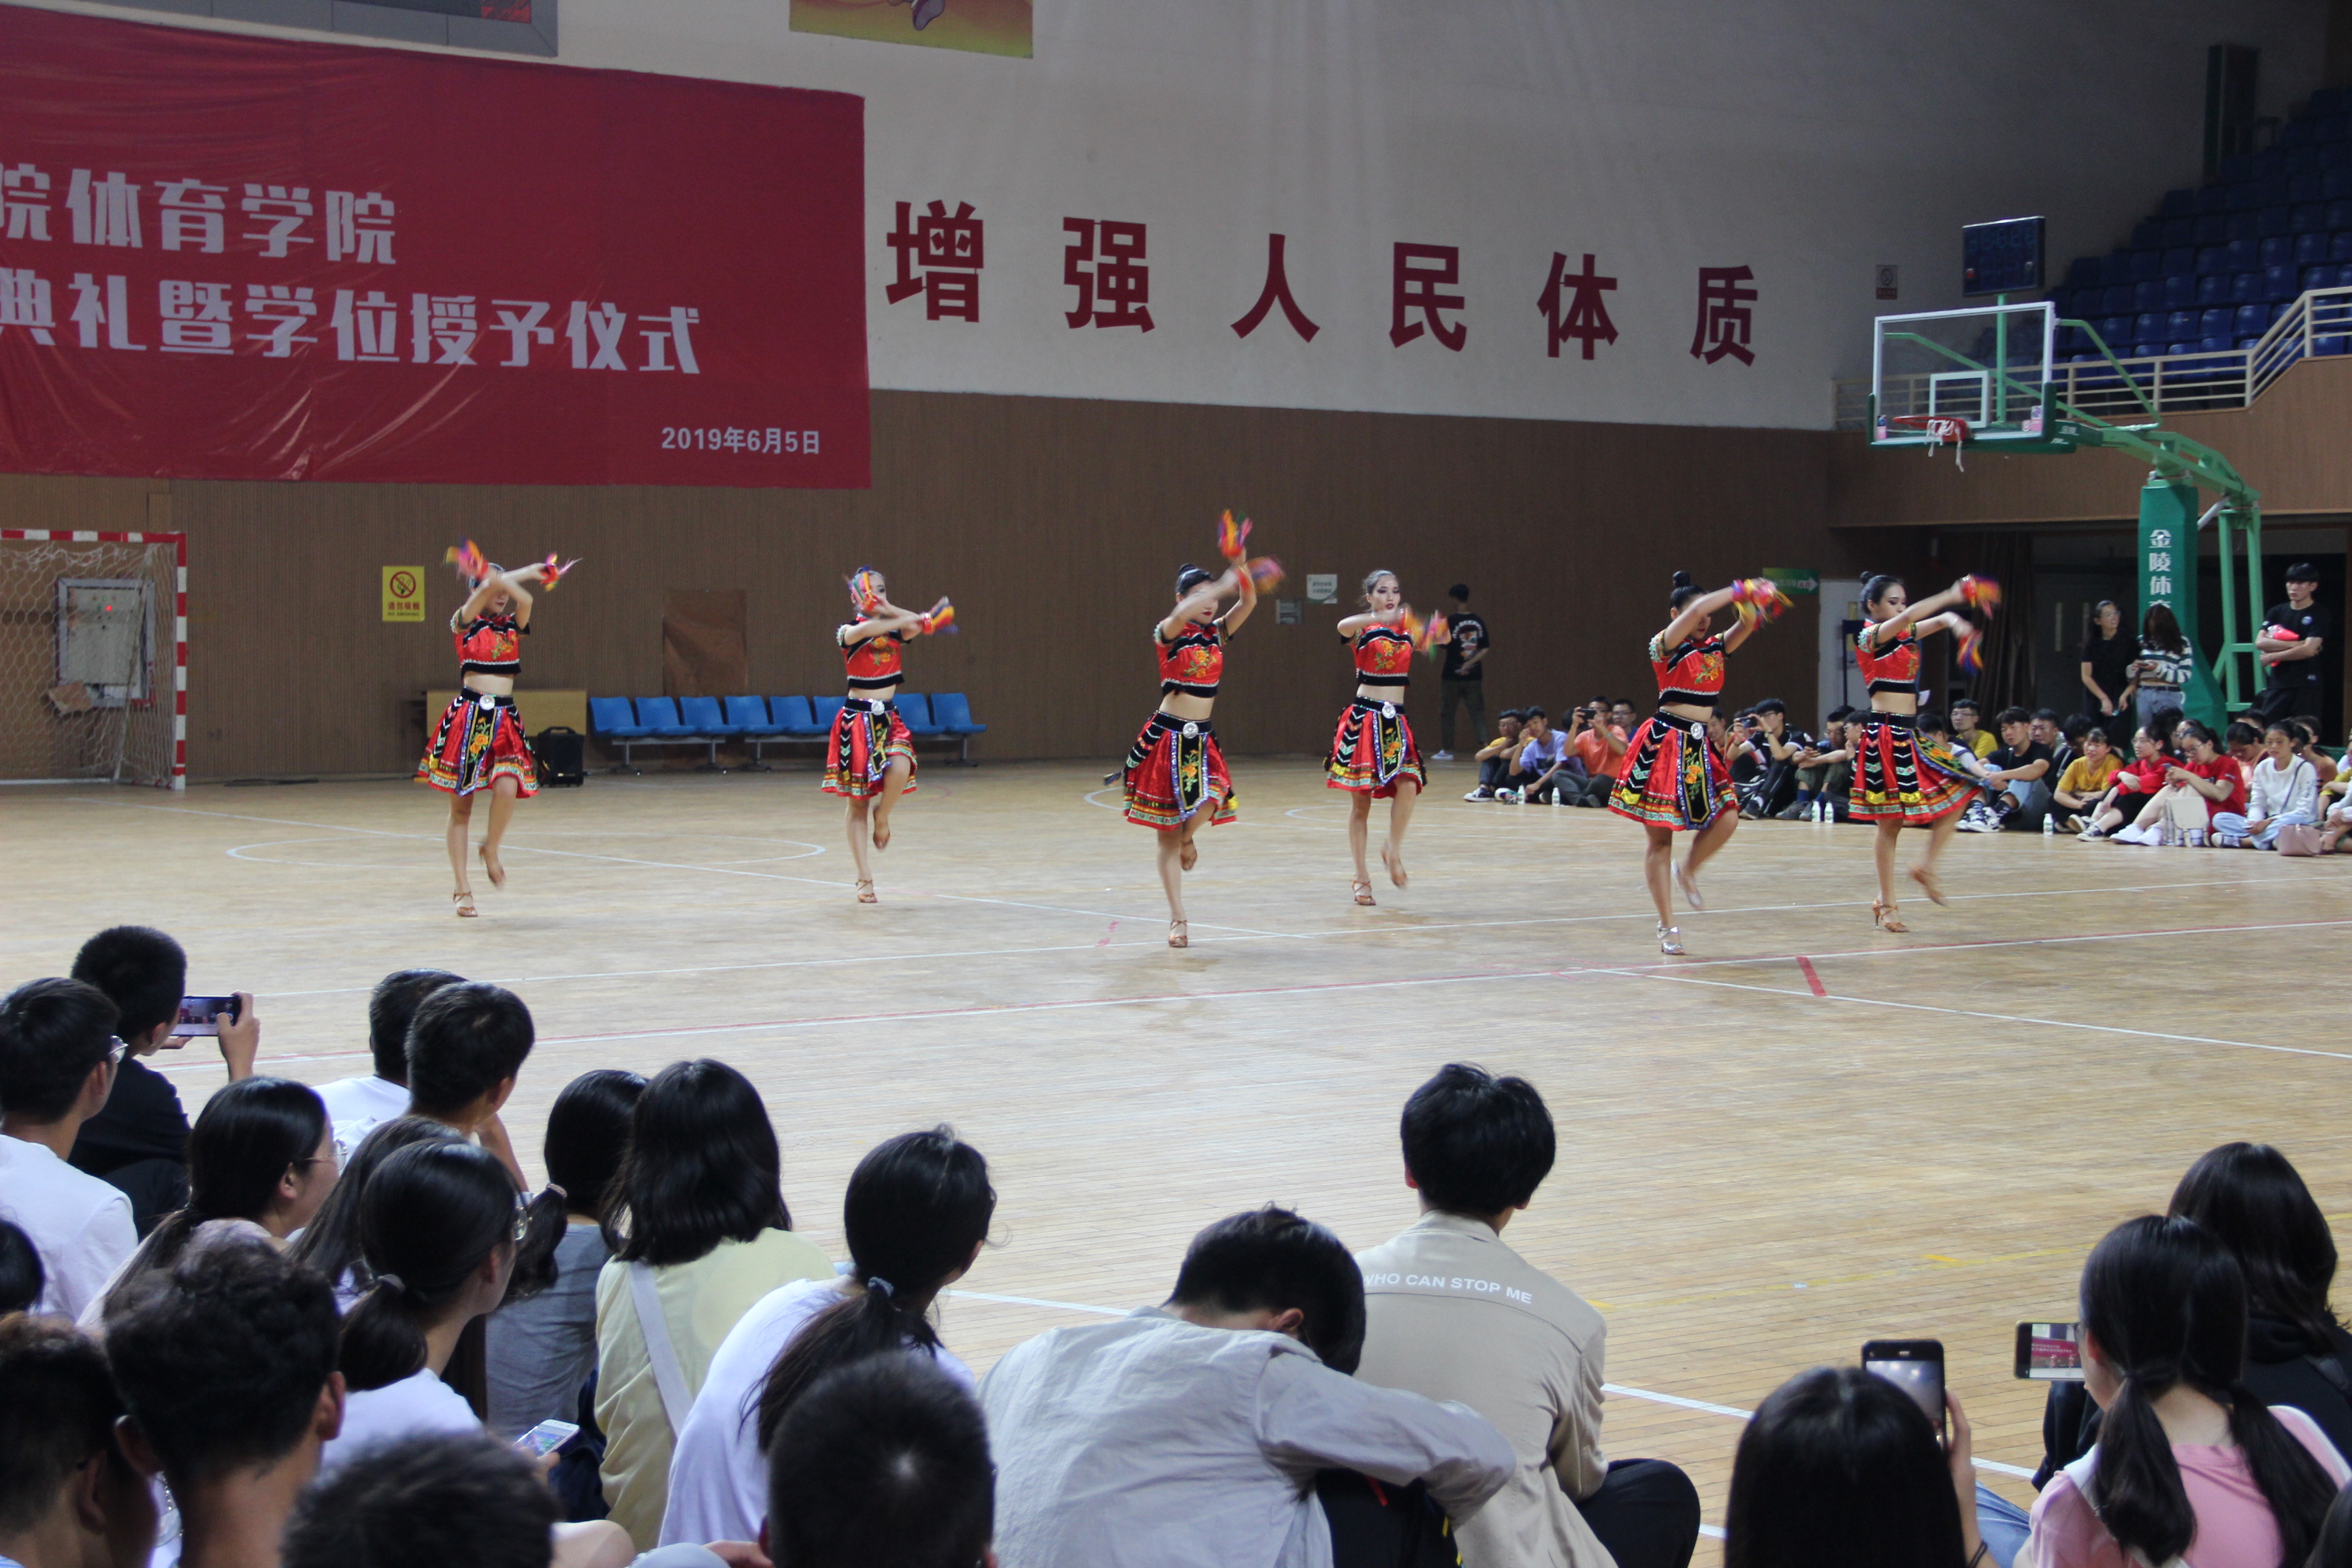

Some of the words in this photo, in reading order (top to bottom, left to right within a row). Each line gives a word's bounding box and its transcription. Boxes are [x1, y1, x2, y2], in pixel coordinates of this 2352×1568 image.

[0, 163, 396, 264] 院体育学院
[0, 268, 700, 374] 典礼暨学位授予仪式
[886, 199, 1758, 367] 增强人民体质
[661, 427, 820, 454] 2019年6月5日
[1362, 1273, 1401, 1286] WHO
[1405, 1274, 1446, 1288] CAN
[1450, 1277, 1501, 1293] STOP
[1506, 1286, 1533, 1305] ME
